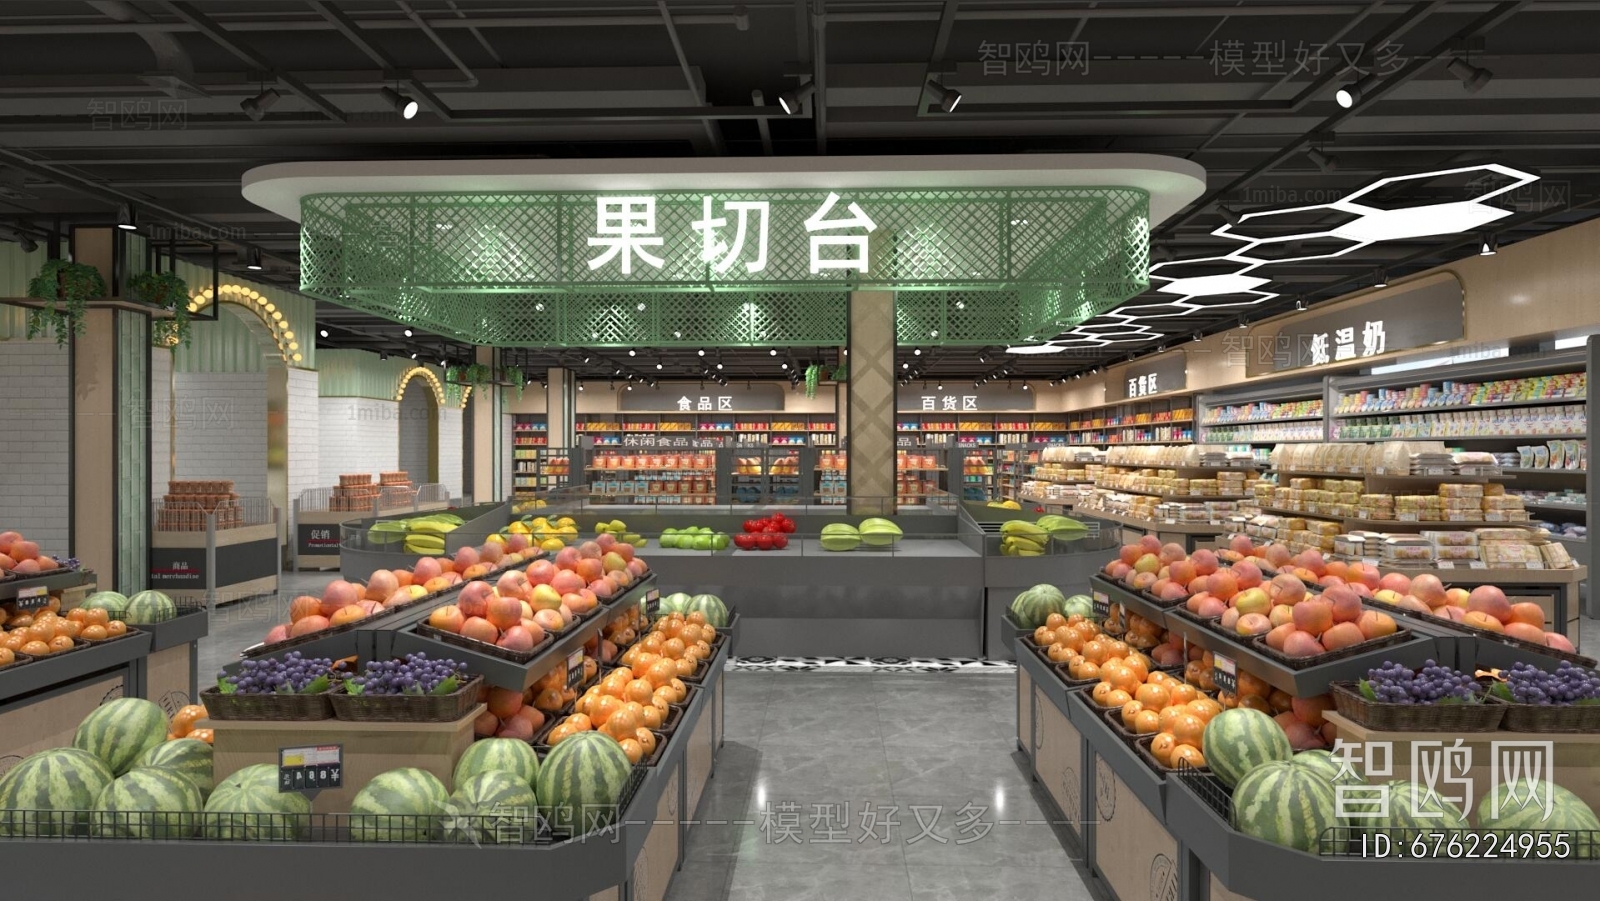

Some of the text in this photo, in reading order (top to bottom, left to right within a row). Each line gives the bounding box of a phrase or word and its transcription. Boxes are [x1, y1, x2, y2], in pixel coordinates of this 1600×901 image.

[587, 192, 877, 274] 果切台
[1311, 320, 1386, 365] 低温奶
[1128, 373, 1158, 398] 百货区
[677, 396, 733, 411] 食品区
[921, 395, 978, 411] 百货区
[623, 437, 689, 447] 休闲食品
[311, 529, 331, 540] 促销
